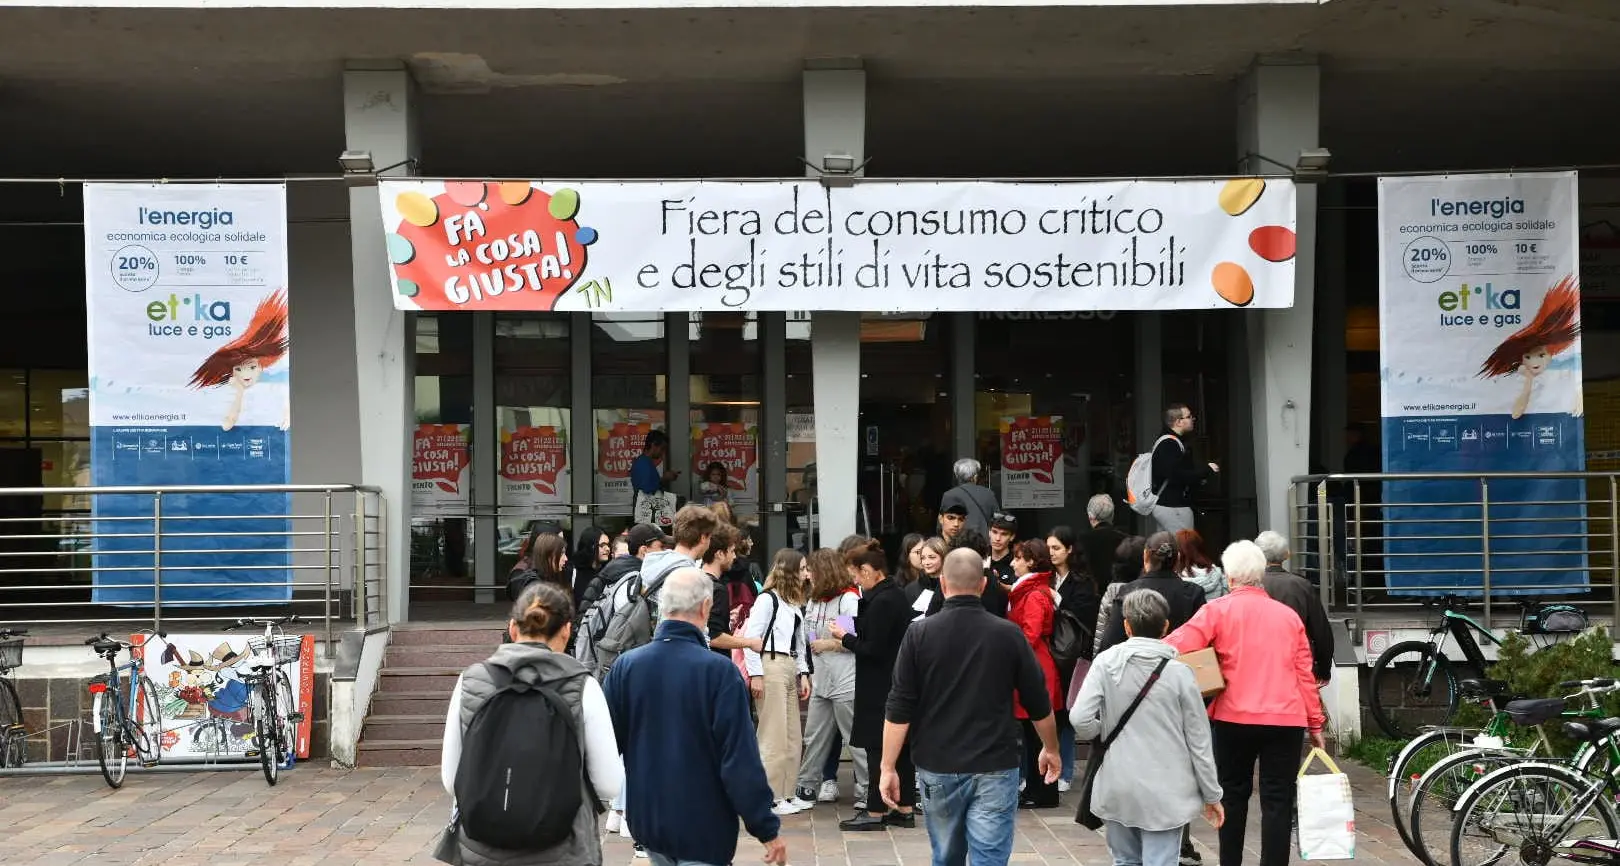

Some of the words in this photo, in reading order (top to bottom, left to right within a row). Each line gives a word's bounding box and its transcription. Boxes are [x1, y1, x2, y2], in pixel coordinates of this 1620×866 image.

[662, 196, 761, 235] Fiera
[774, 185, 833, 235] del
[845, 209, 1026, 236] consumo
[1039, 195, 1163, 235] critico
[1431, 197, 1524, 218] l'energia
[139, 207, 233, 229] l'energia
[1400, 224, 1459, 234] economica
[1462, 221, 1513, 233] ecologica
[1515, 220, 1556, 230] solidale
[107, 232, 166, 241] economica
[170, 231, 220, 243] ecologica
[225, 231, 266, 242] solidale
[446, 248, 470, 267] LA
[476, 230, 541, 265] COSA
[1411, 248, 1447, 261] 20%
[1465, 244, 1498, 255] 100%
[1515, 243, 1528, 253] 10
[1530, 244, 1537, 253] €
[118, 256, 155, 270] 20%
[174, 255, 206, 265] 100%
[223, 255, 238, 265] 10
[240, 256, 248, 265] €
[444, 231, 573, 304] GIUSTA!
[637, 263, 659, 288] e
[672, 238, 766, 307] degli
[778, 237, 843, 288] stili
[855, 239, 890, 288] di
[902, 249, 971, 288] vita
[984, 235, 1186, 288] sostenibili
[576, 276, 612, 308] TN
[1440, 313, 1474, 327] luce
[1479, 315, 1489, 326] e
[1493, 313, 1521, 328] gas
[149, 323, 182, 336] luce
[187, 326, 198, 336] e
[203, 326, 231, 339] gas
[712, 447, 736, 458] COSA
[1020, 440, 1043, 451] COSA
[423, 449, 449, 460] COSA
[520, 451, 546, 461] COSA
[1006, 444, 1052, 464] GIUSTA!
[506, 454, 556, 475] GIUSTA!
